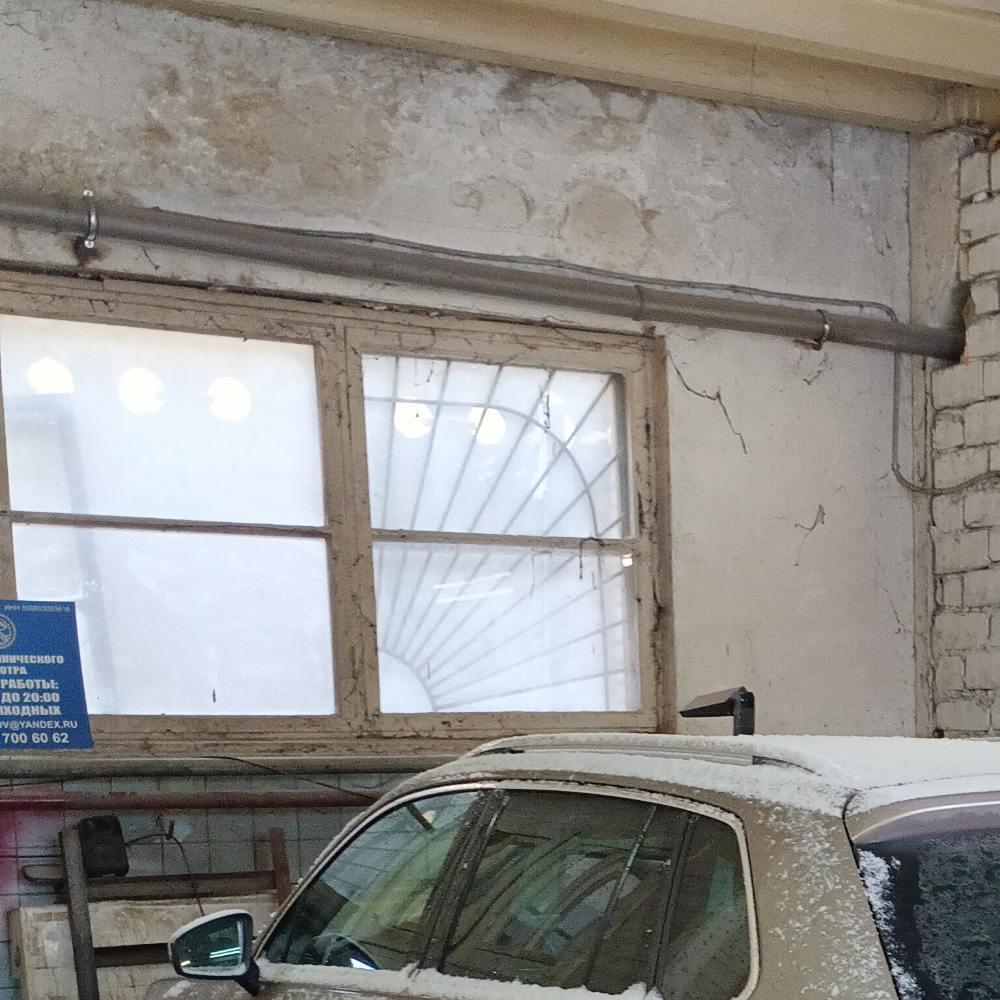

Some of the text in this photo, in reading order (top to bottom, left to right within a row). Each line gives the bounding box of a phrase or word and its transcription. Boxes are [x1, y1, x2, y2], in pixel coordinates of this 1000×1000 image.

[1, 679, 59, 690] РАБОТЫ:
[1, 692, 60, 704] ДО 20:00
[2, 732, 70, 744] 700 60 62
